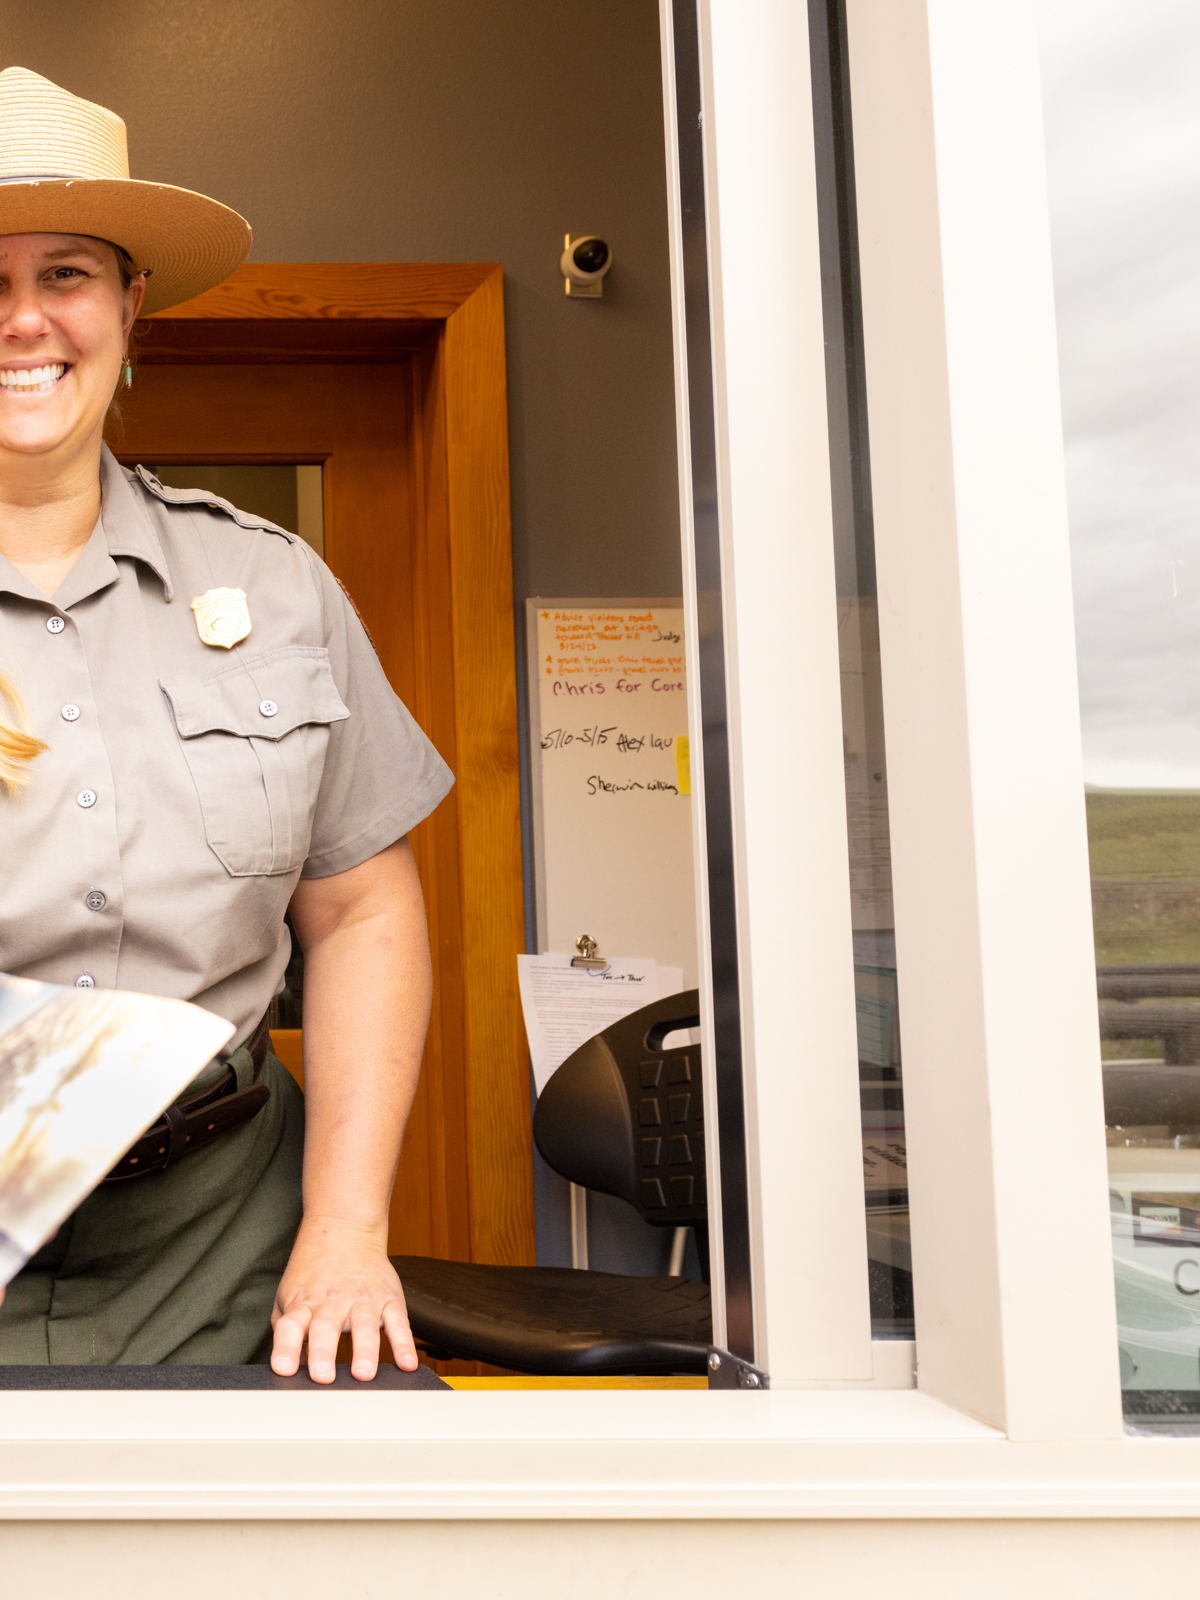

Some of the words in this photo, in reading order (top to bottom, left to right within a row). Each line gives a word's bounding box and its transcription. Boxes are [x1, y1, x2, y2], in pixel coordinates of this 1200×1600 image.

[603, 624, 619, 632] at
[553, 680, 606, 696] Chris
[615, 678, 642, 693] for
[651, 678, 684, 692] Core
[1141, 1214, 1179, 1223] DISCOVER
